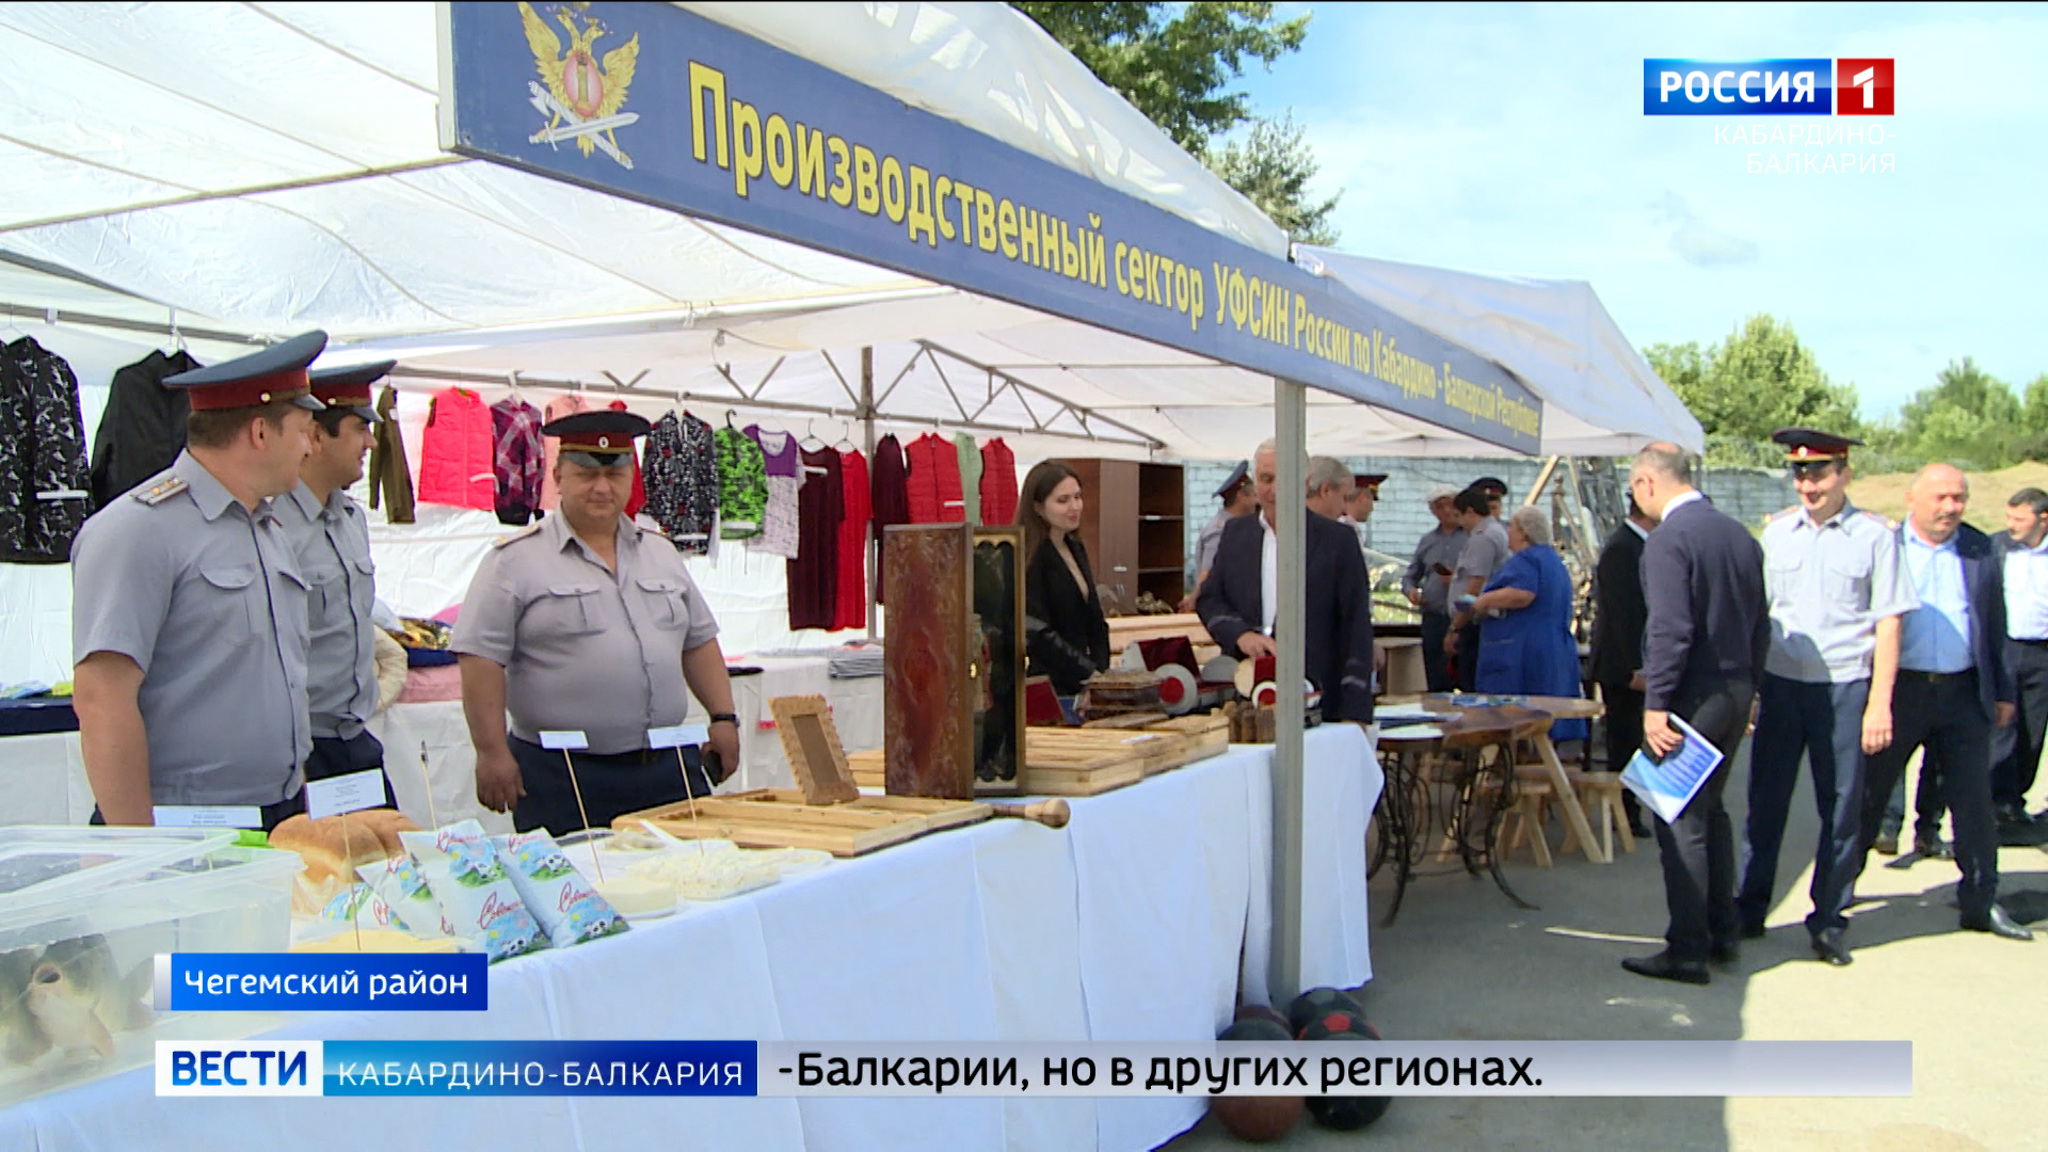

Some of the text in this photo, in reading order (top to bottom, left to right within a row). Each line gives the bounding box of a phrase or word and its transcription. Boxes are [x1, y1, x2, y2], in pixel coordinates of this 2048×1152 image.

[687, 58, 1108, 288] Производственный
[1113, 240, 1205, 332] сектор
[1212, 260, 1291, 346] УФСИН
[1294, 292, 1352, 368] России
[1353, 331, 1371, 375] по
[1373, 327, 1437, 400] Кабардино
